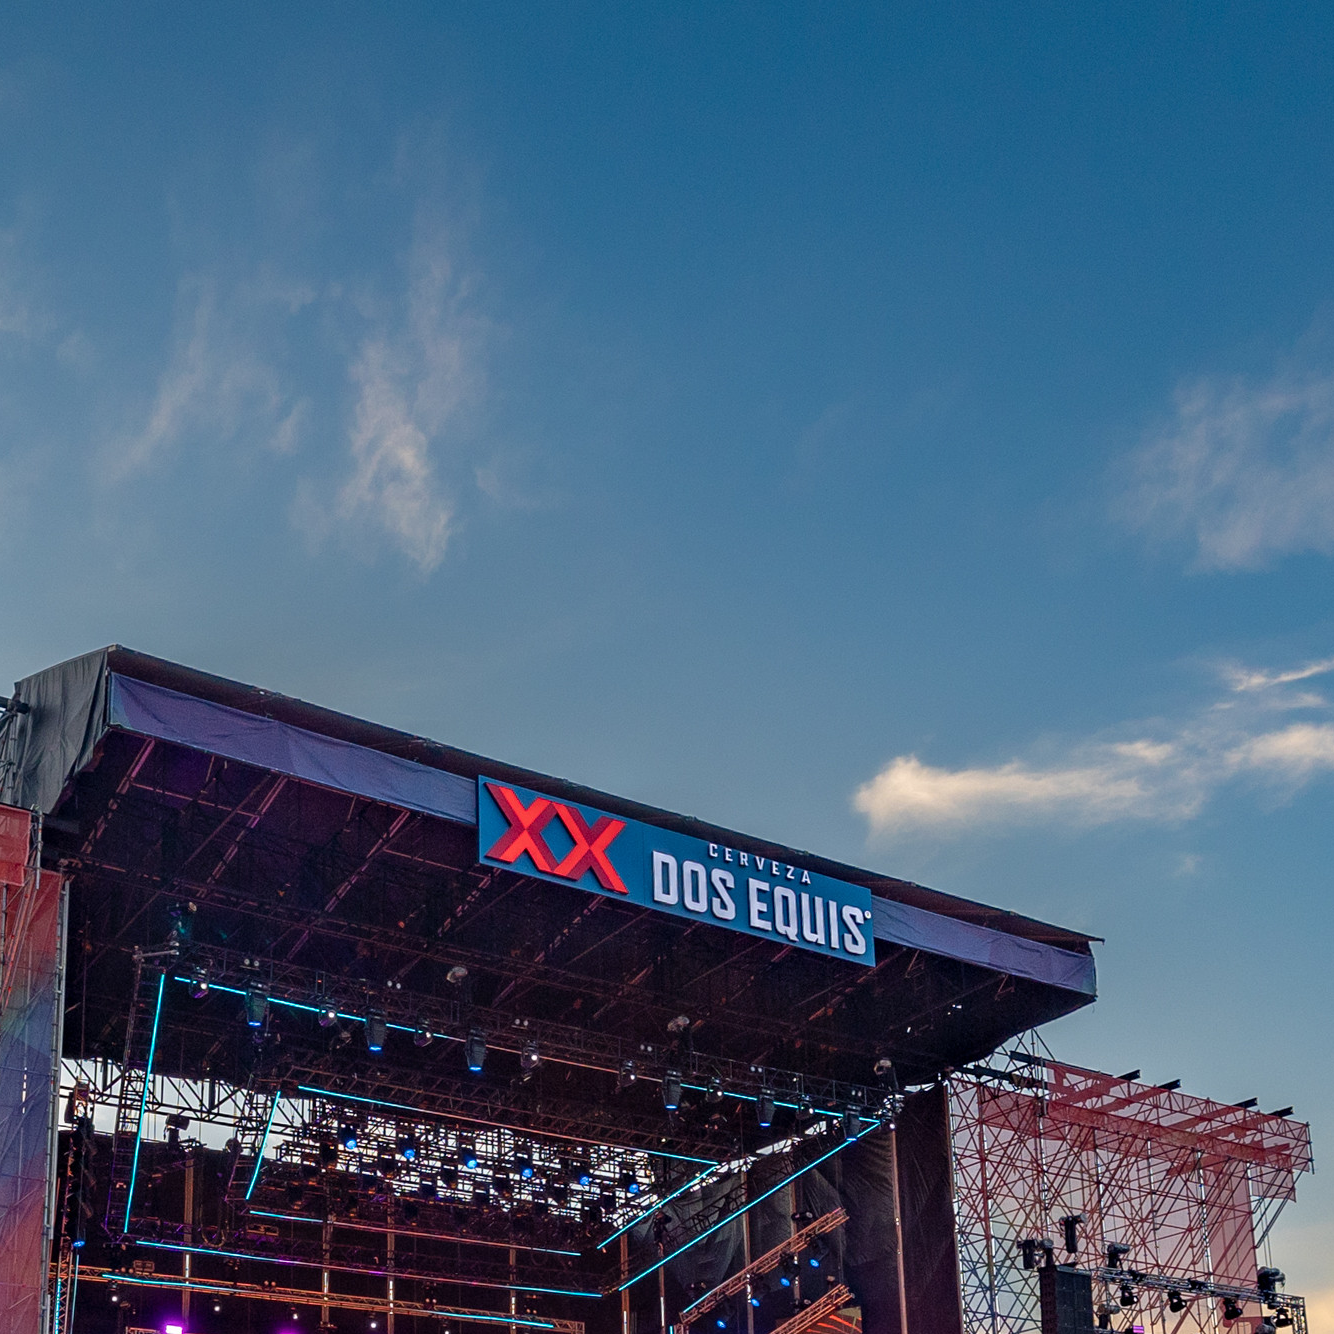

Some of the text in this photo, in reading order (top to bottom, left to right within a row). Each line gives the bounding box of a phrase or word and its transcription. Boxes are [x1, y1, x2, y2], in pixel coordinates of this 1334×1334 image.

[484, 782, 629, 895] XX
[708, 843, 812, 885] CERVEZA
[652, 850, 867, 956] DOS EQUIS
